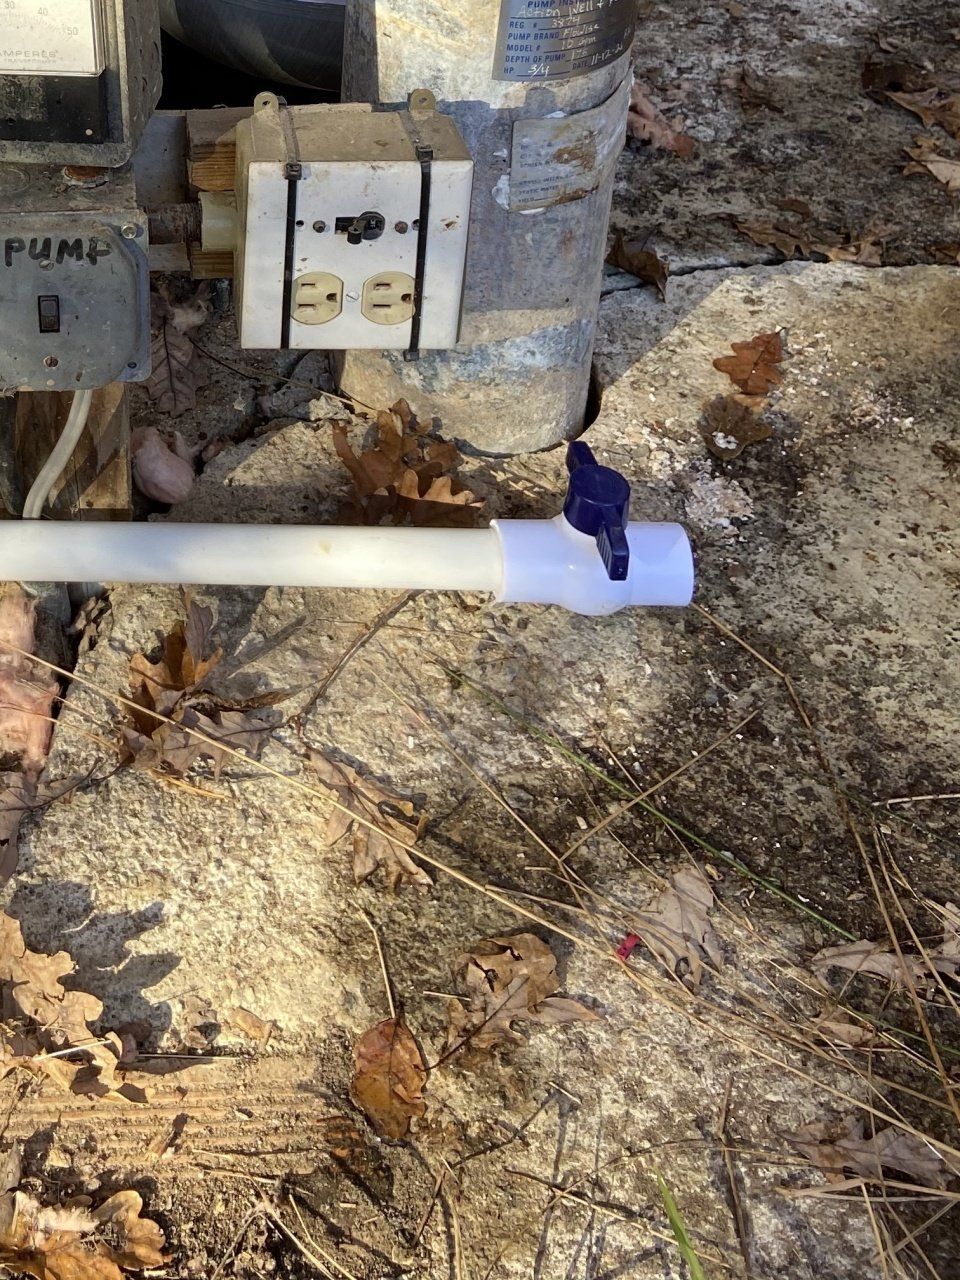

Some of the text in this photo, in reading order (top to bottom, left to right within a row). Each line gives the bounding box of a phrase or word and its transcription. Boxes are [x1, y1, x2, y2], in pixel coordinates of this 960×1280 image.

[4, 0, 15, 10] 30
[527, 0, 556, 8] PUMP
[509, 21, 525, 29] REG
[66, 26, 79, 36] 50
[508, 32, 531, 40] PUMP
[533, 31, 560, 41] BRAND
[506, 44, 532, 52] MODEL
[505, 55, 530, 63] DEPTH
[533, 55, 543, 63] OF
[545, 53, 566, 62] PUMP
[527, 63, 550, 80] 3/4
[4, 236, 113, 268] PUMP
